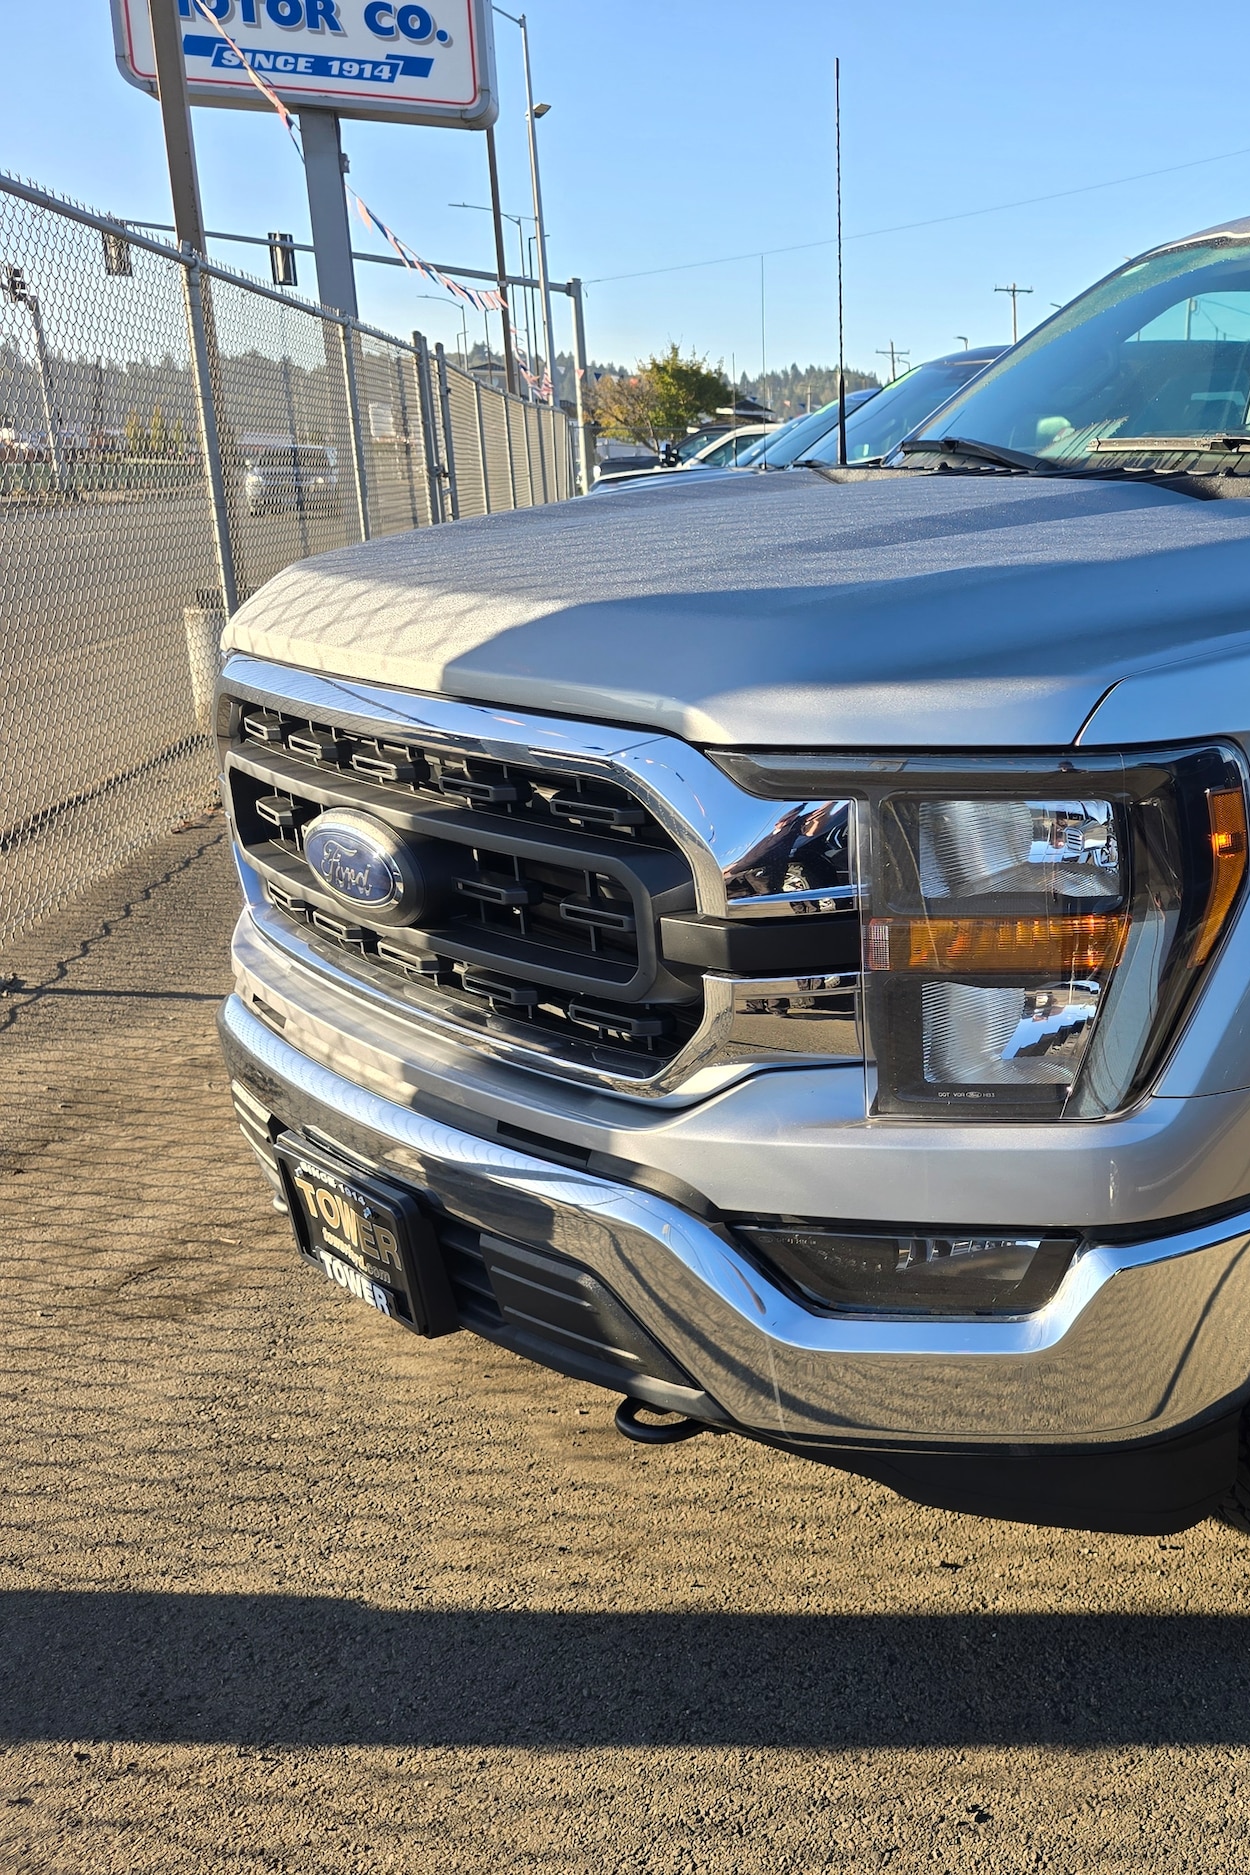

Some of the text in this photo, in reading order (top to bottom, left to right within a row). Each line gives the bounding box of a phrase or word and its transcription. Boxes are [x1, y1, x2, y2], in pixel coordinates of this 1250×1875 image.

[363, 0, 451, 43] CO.
[220, 49, 392, 81] SINCE 1914
[320, 839, 373, 897] Ford
[299, 1161, 366, 1206] SINCE 1914
[294, 1176, 402, 1272] TOWER
[319, 1250, 390, 1317] TOWER
[322, 1226, 391, 1285] towerford.com
